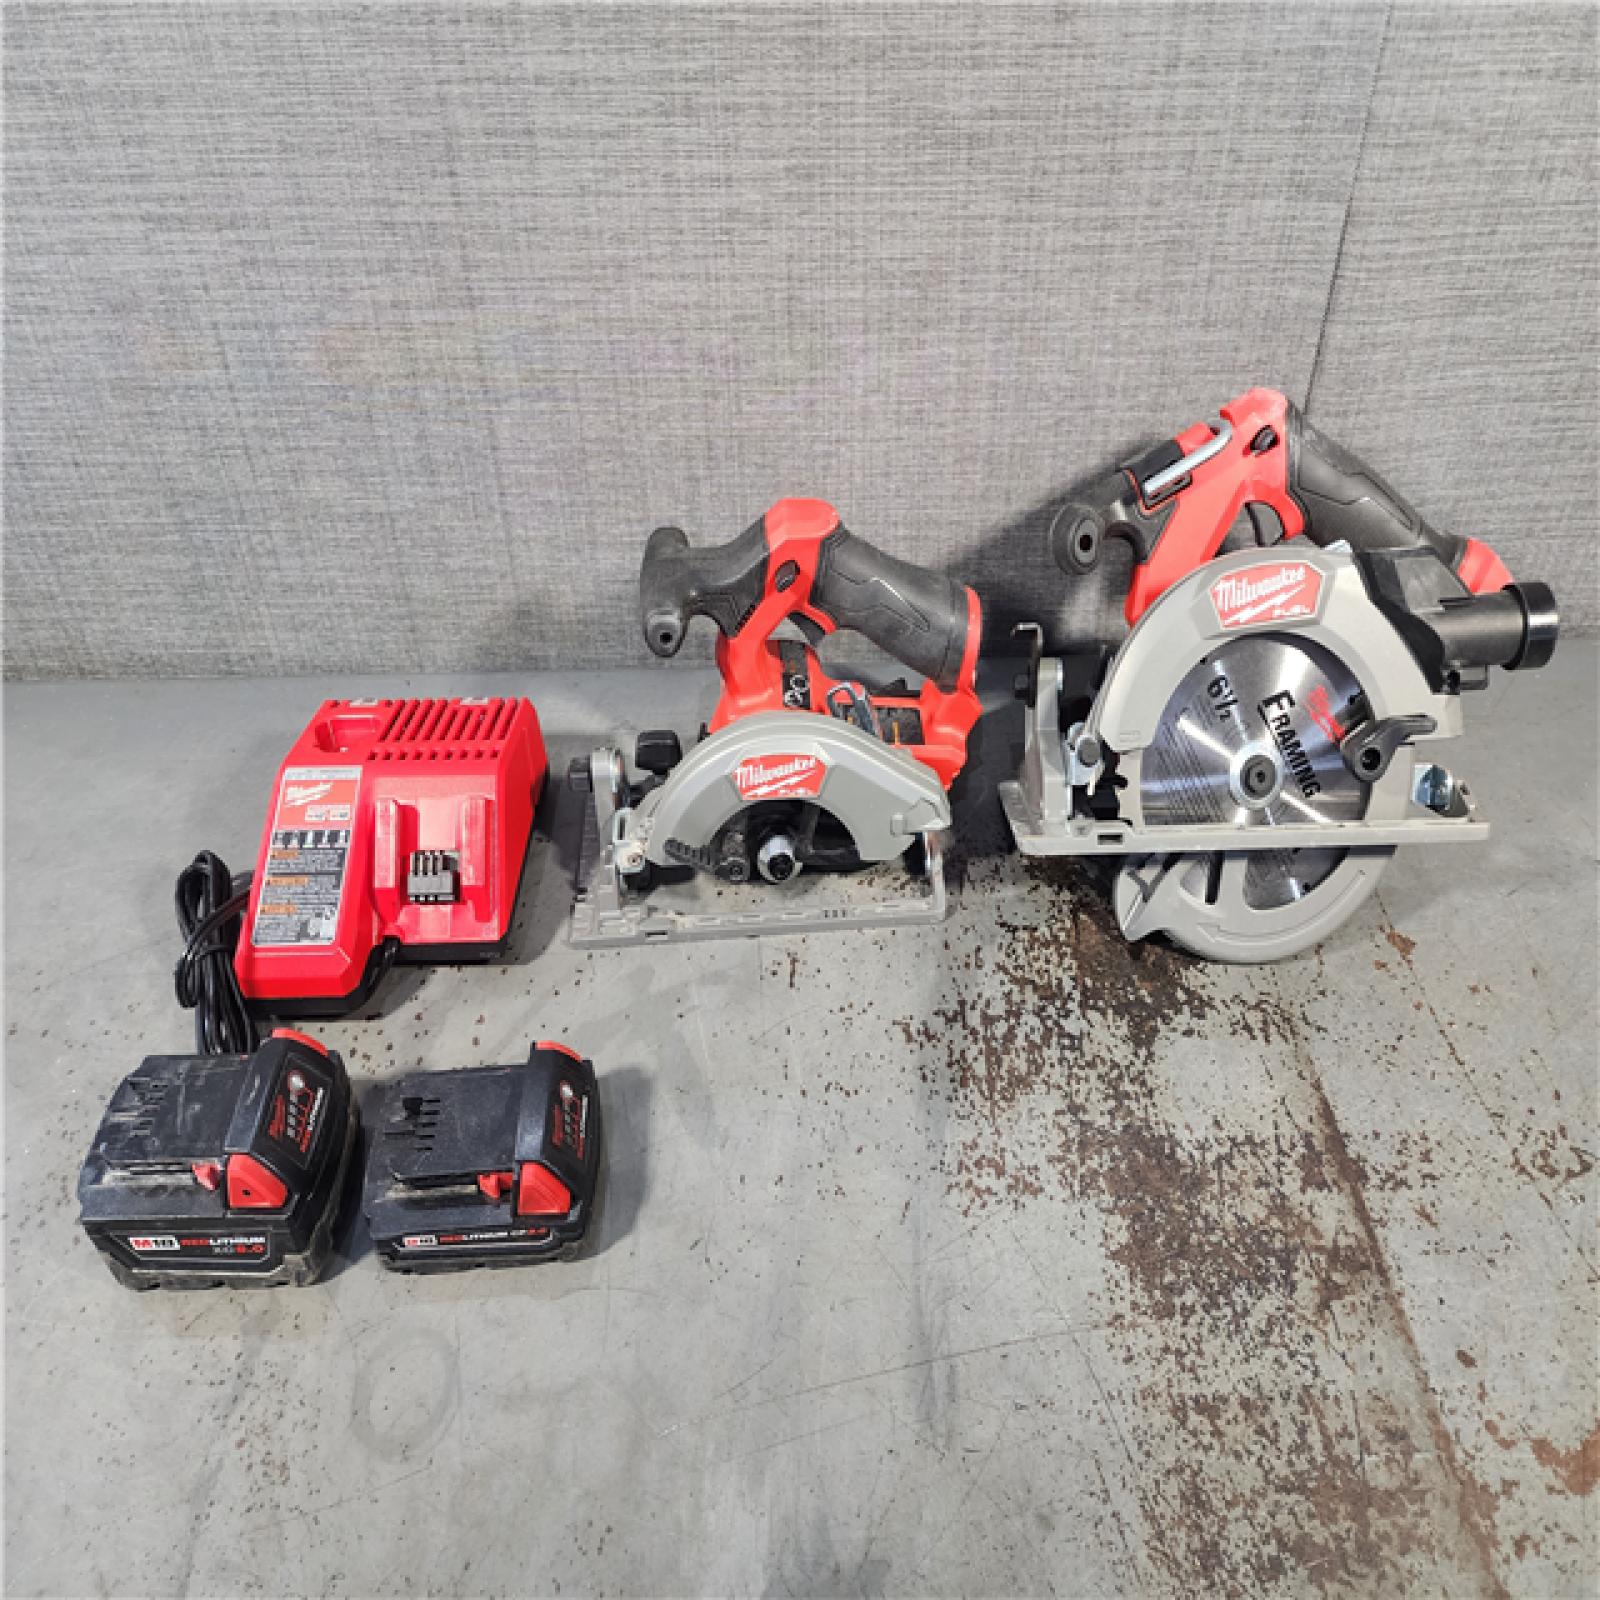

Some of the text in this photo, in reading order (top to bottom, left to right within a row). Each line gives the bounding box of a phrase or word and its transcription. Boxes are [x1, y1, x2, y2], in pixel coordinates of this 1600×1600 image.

[1214, 565, 1305, 613] Milwaukee
[1258, 689, 1322, 798] FRAMING
[734, 755, 816, 789] Milwaukee
